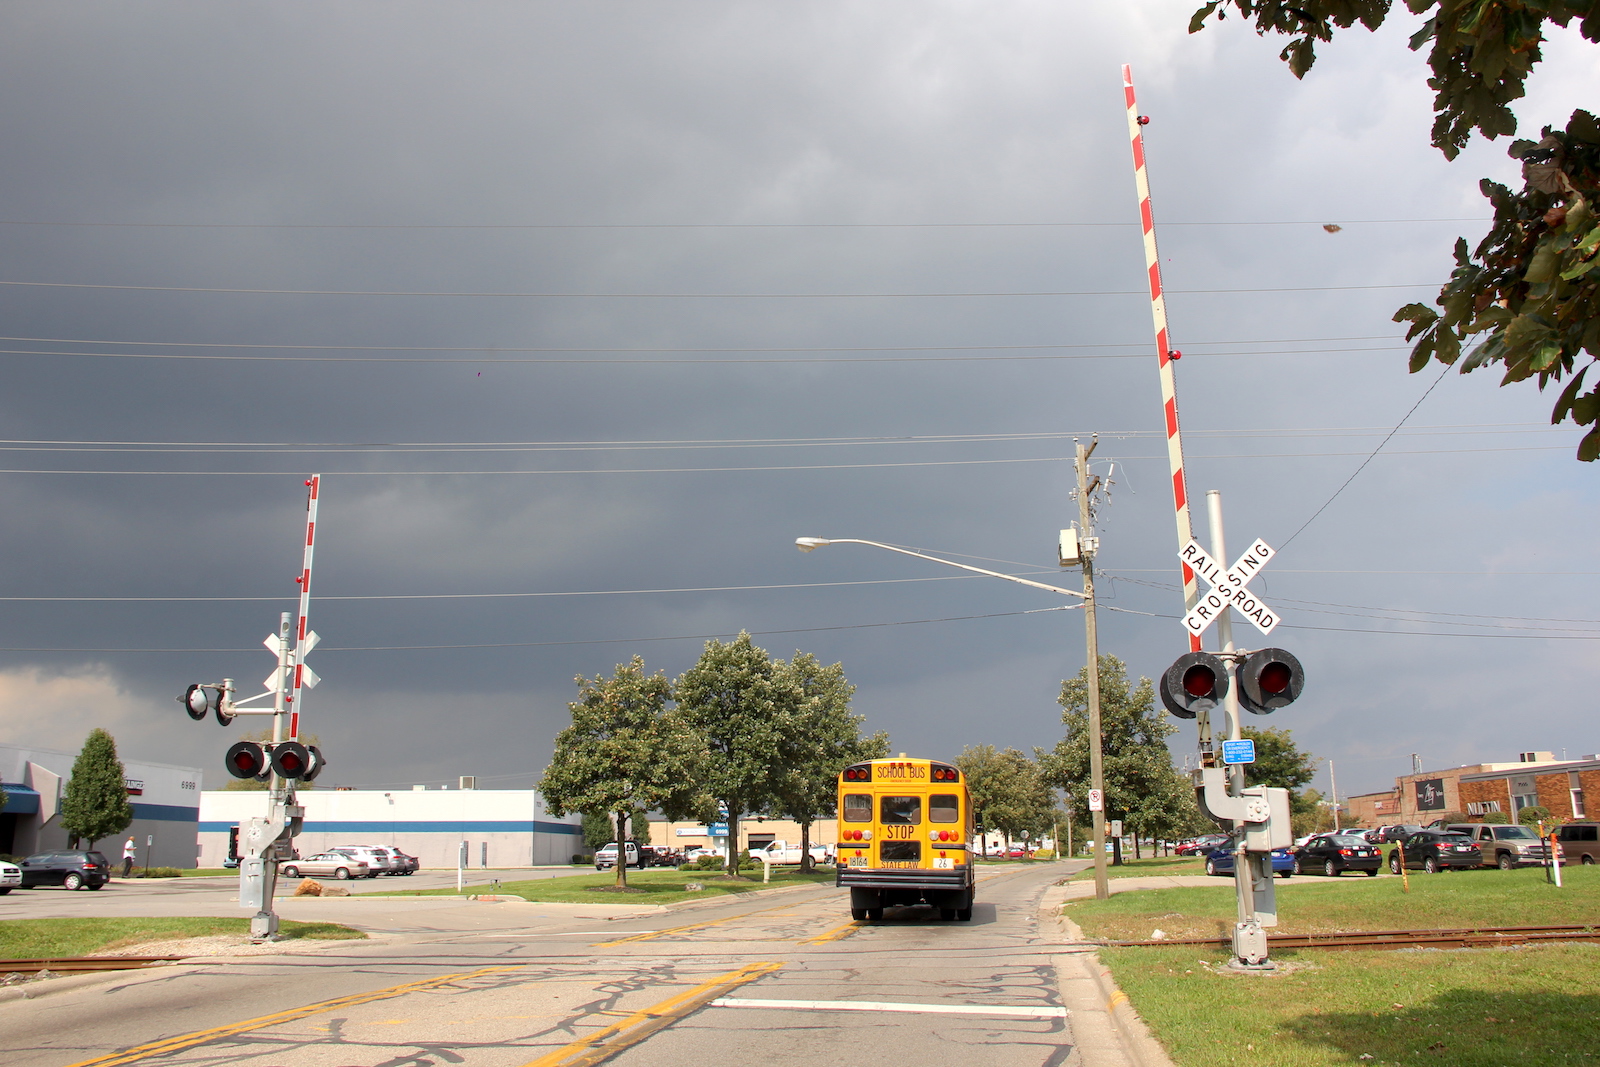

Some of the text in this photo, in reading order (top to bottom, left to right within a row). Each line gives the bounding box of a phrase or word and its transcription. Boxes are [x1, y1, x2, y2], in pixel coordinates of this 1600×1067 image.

[1183, 544, 1219, 585] RAIL
[1187, 544, 1269, 630] CROSSING
[1232, 590, 1273, 628] ROAD
[877, 766, 925, 778] SCHOOL BUS
[181, 781, 195, 790] 6999
[887, 825, 914, 839] STOP
[881, 861, 918, 869] STATE LAW
[938, 859, 947, 868] 26
